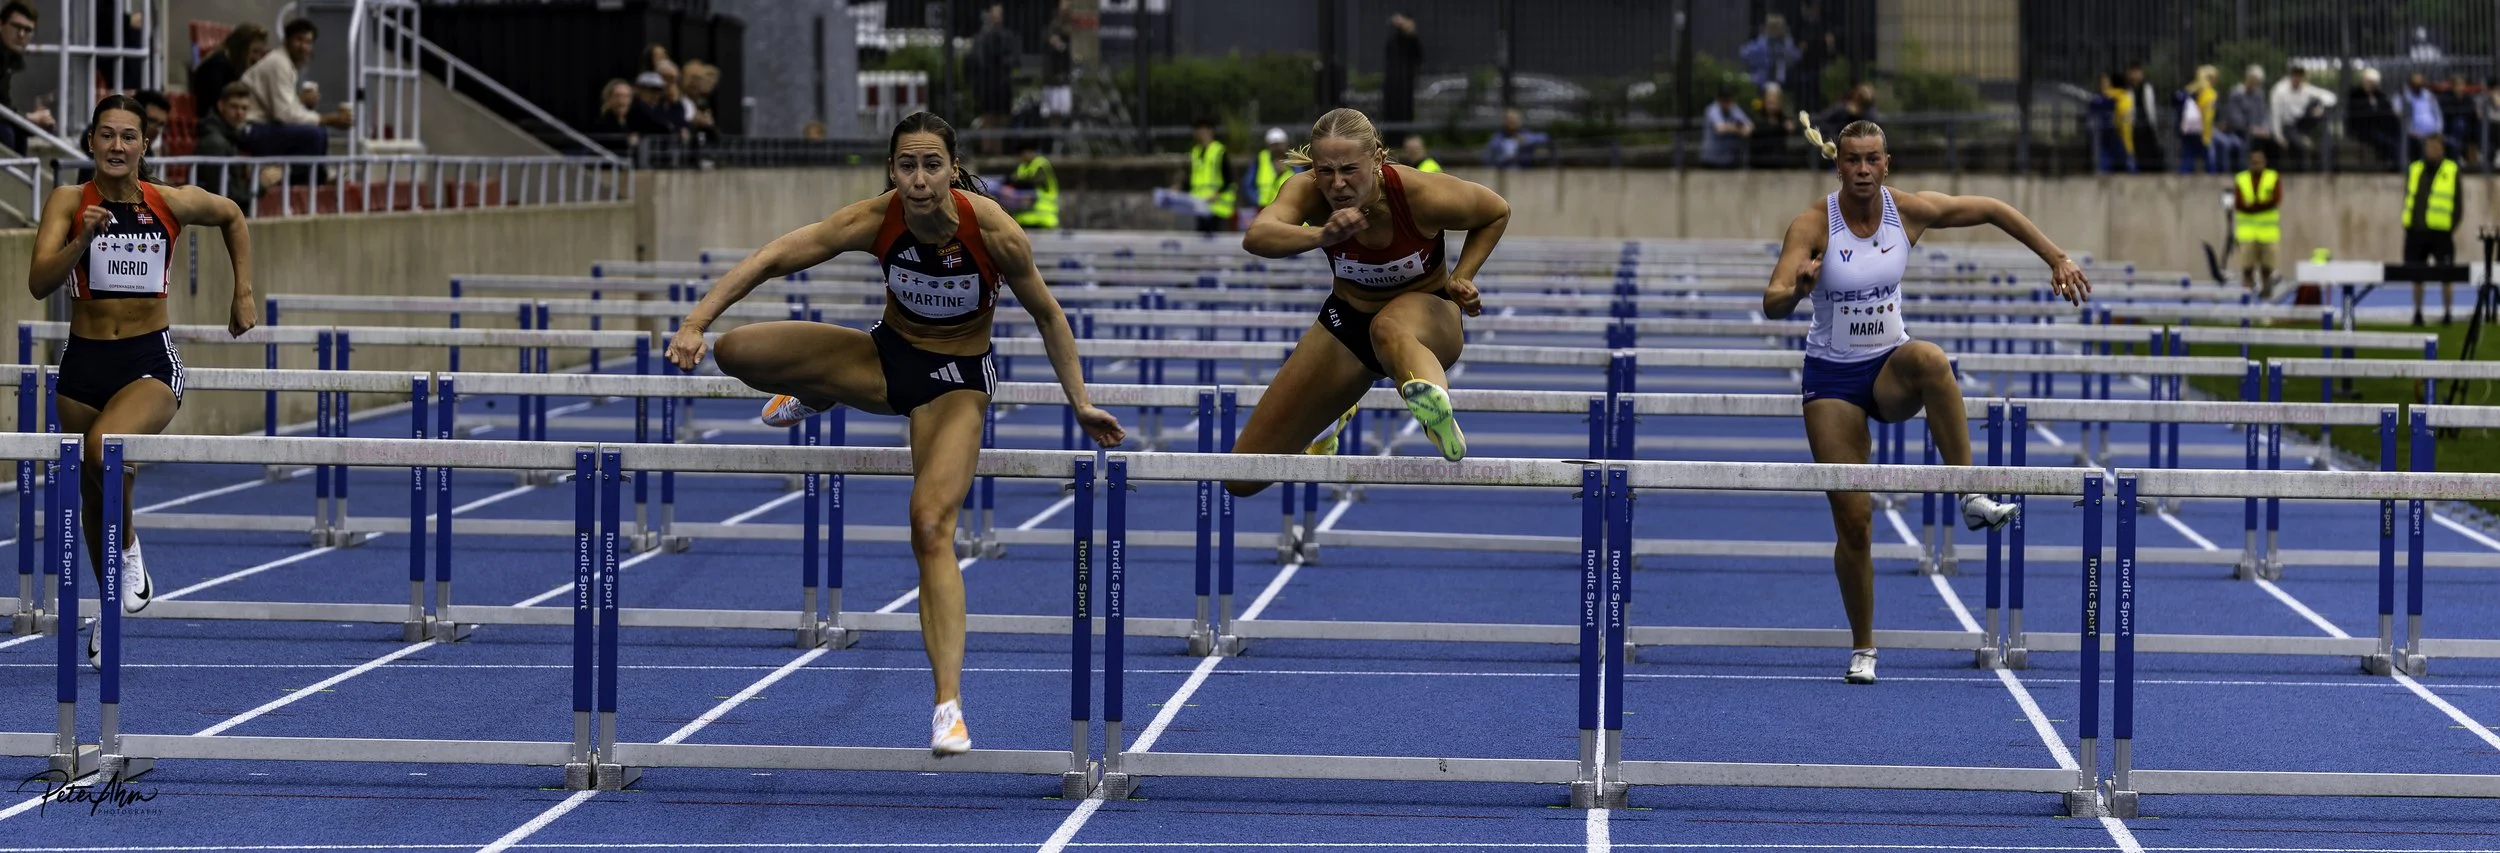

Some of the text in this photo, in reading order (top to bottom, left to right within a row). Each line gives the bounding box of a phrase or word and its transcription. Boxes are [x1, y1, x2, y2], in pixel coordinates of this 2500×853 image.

[107, 260, 148, 276] INGRID
[902, 290, 966, 308] MARTINE
[1850, 320, 1885, 336] MARÍA
[23, 467, 31, 494] Sport
[414, 467, 422, 490] port
[440, 467, 448, 491] port
[807, 473, 815, 497] port
[832, 481, 840, 508] Sport
[1200, 489, 1208, 516] Sport
[62, 509, 73, 586] nordic Sport
[106, 524, 117, 602] nordic Sport
[579, 532, 589, 610] nordic Sport
[604, 532, 614, 610] nordic Sport
[1077, 540, 1088, 618] nordic Sport
[1110, 540, 1121, 618] nordic Sport
[1585, 550, 1596, 627] nordic Sport
[1610, 550, 1621, 628] nordic Sport
[2086, 558, 2098, 636] nordic Sport
[2120, 559, 2131, 637] nordic Sport
